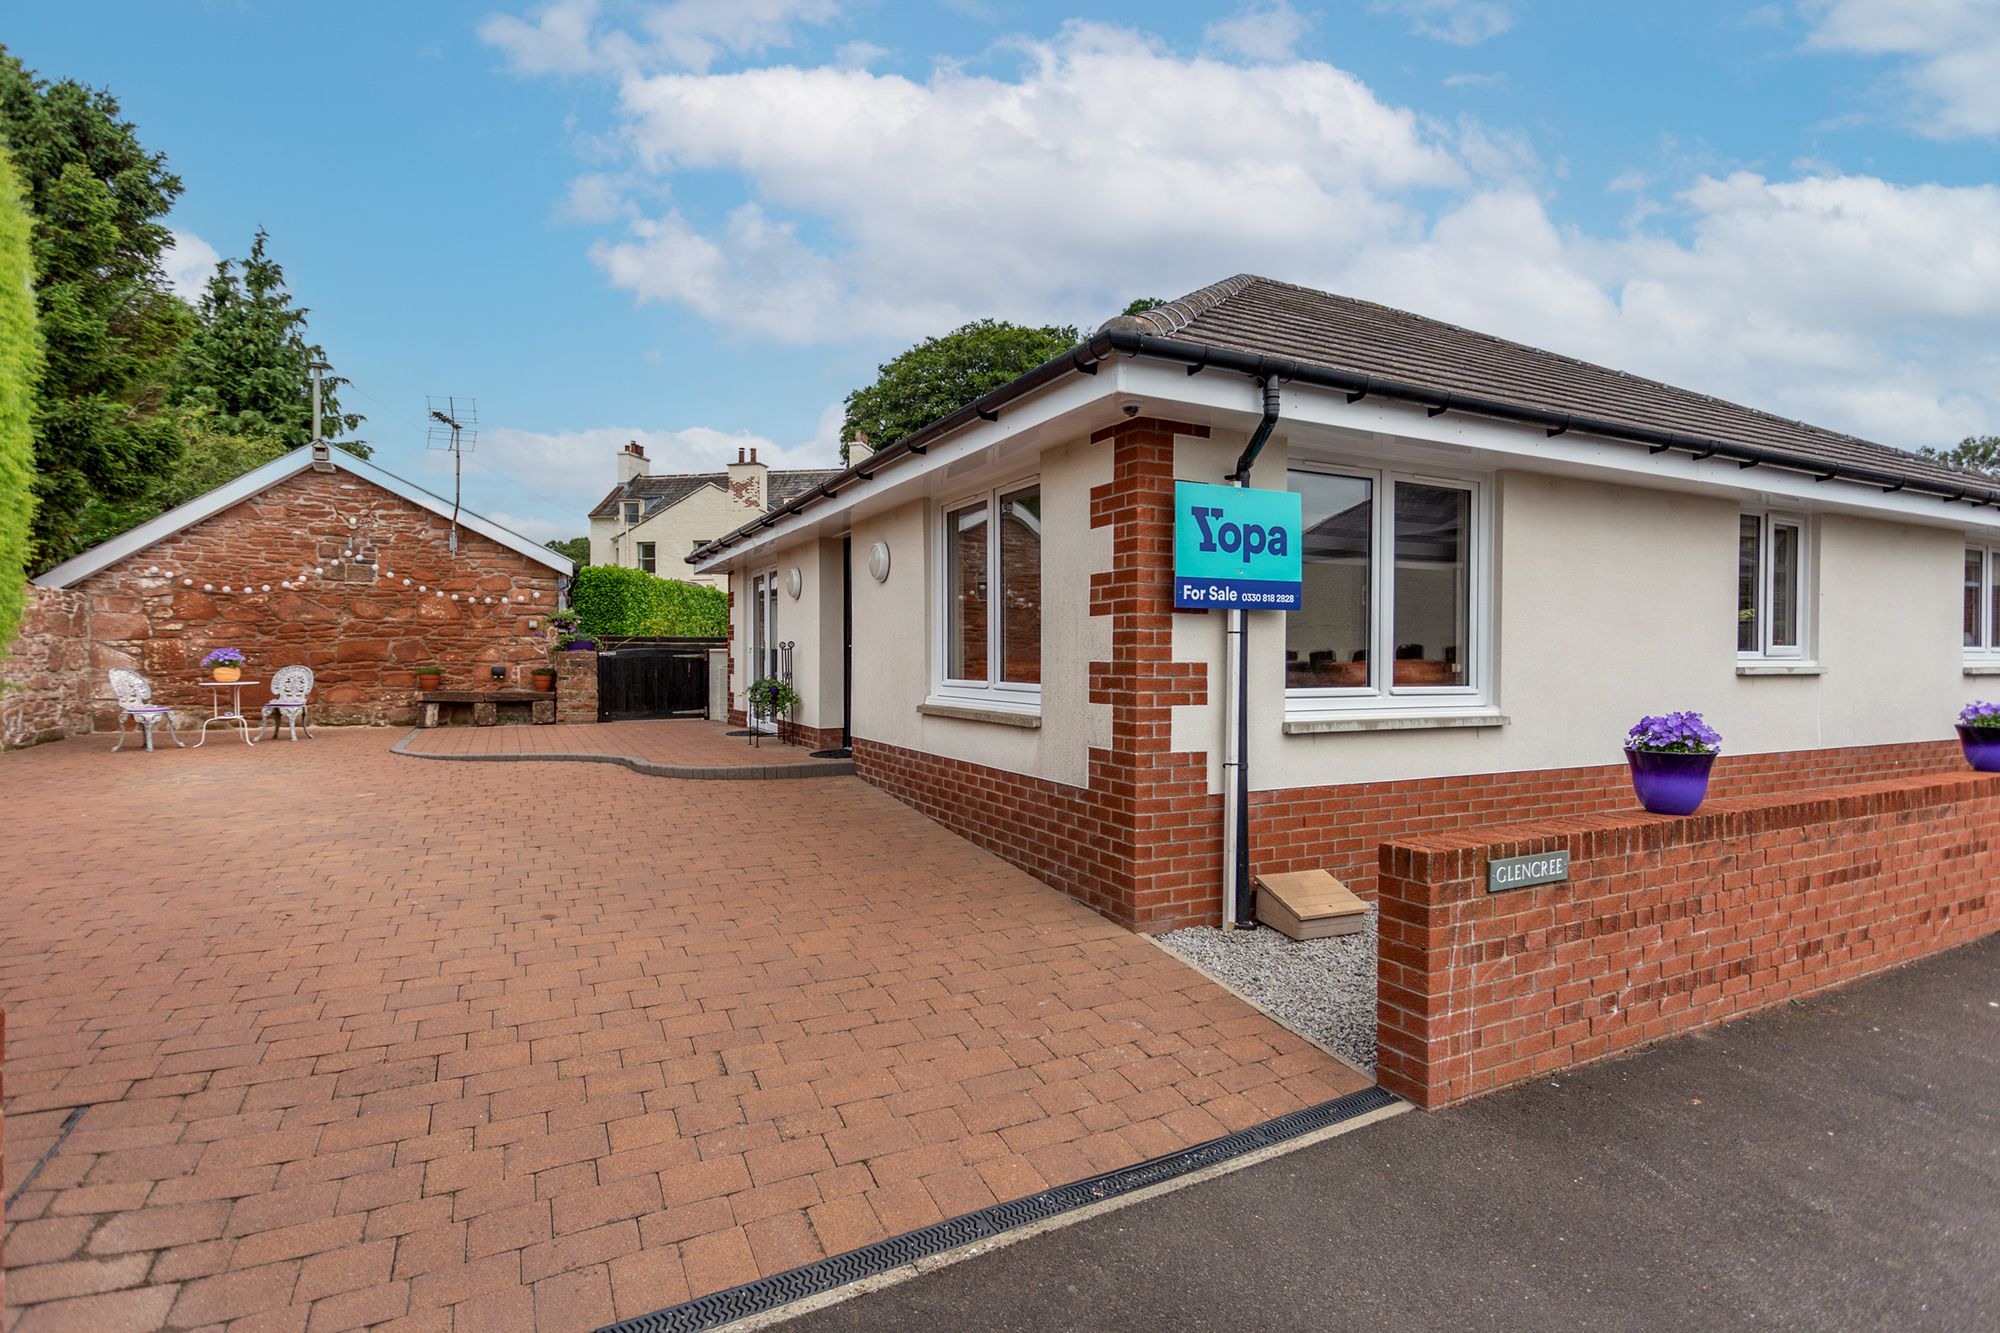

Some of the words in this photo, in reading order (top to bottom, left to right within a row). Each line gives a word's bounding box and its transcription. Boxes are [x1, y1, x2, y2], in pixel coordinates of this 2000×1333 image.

[1191, 506, 1287, 563] Yopa
[1183, 585, 1206, 601] For
[1208, 586, 1238, 602] Sale
[1241, 593, 1261, 602] 0330
[1262, 594, 1275, 603] 818
[1276, 594, 1294, 603] 2828
[1496, 858, 1563, 883] GLENCREE
